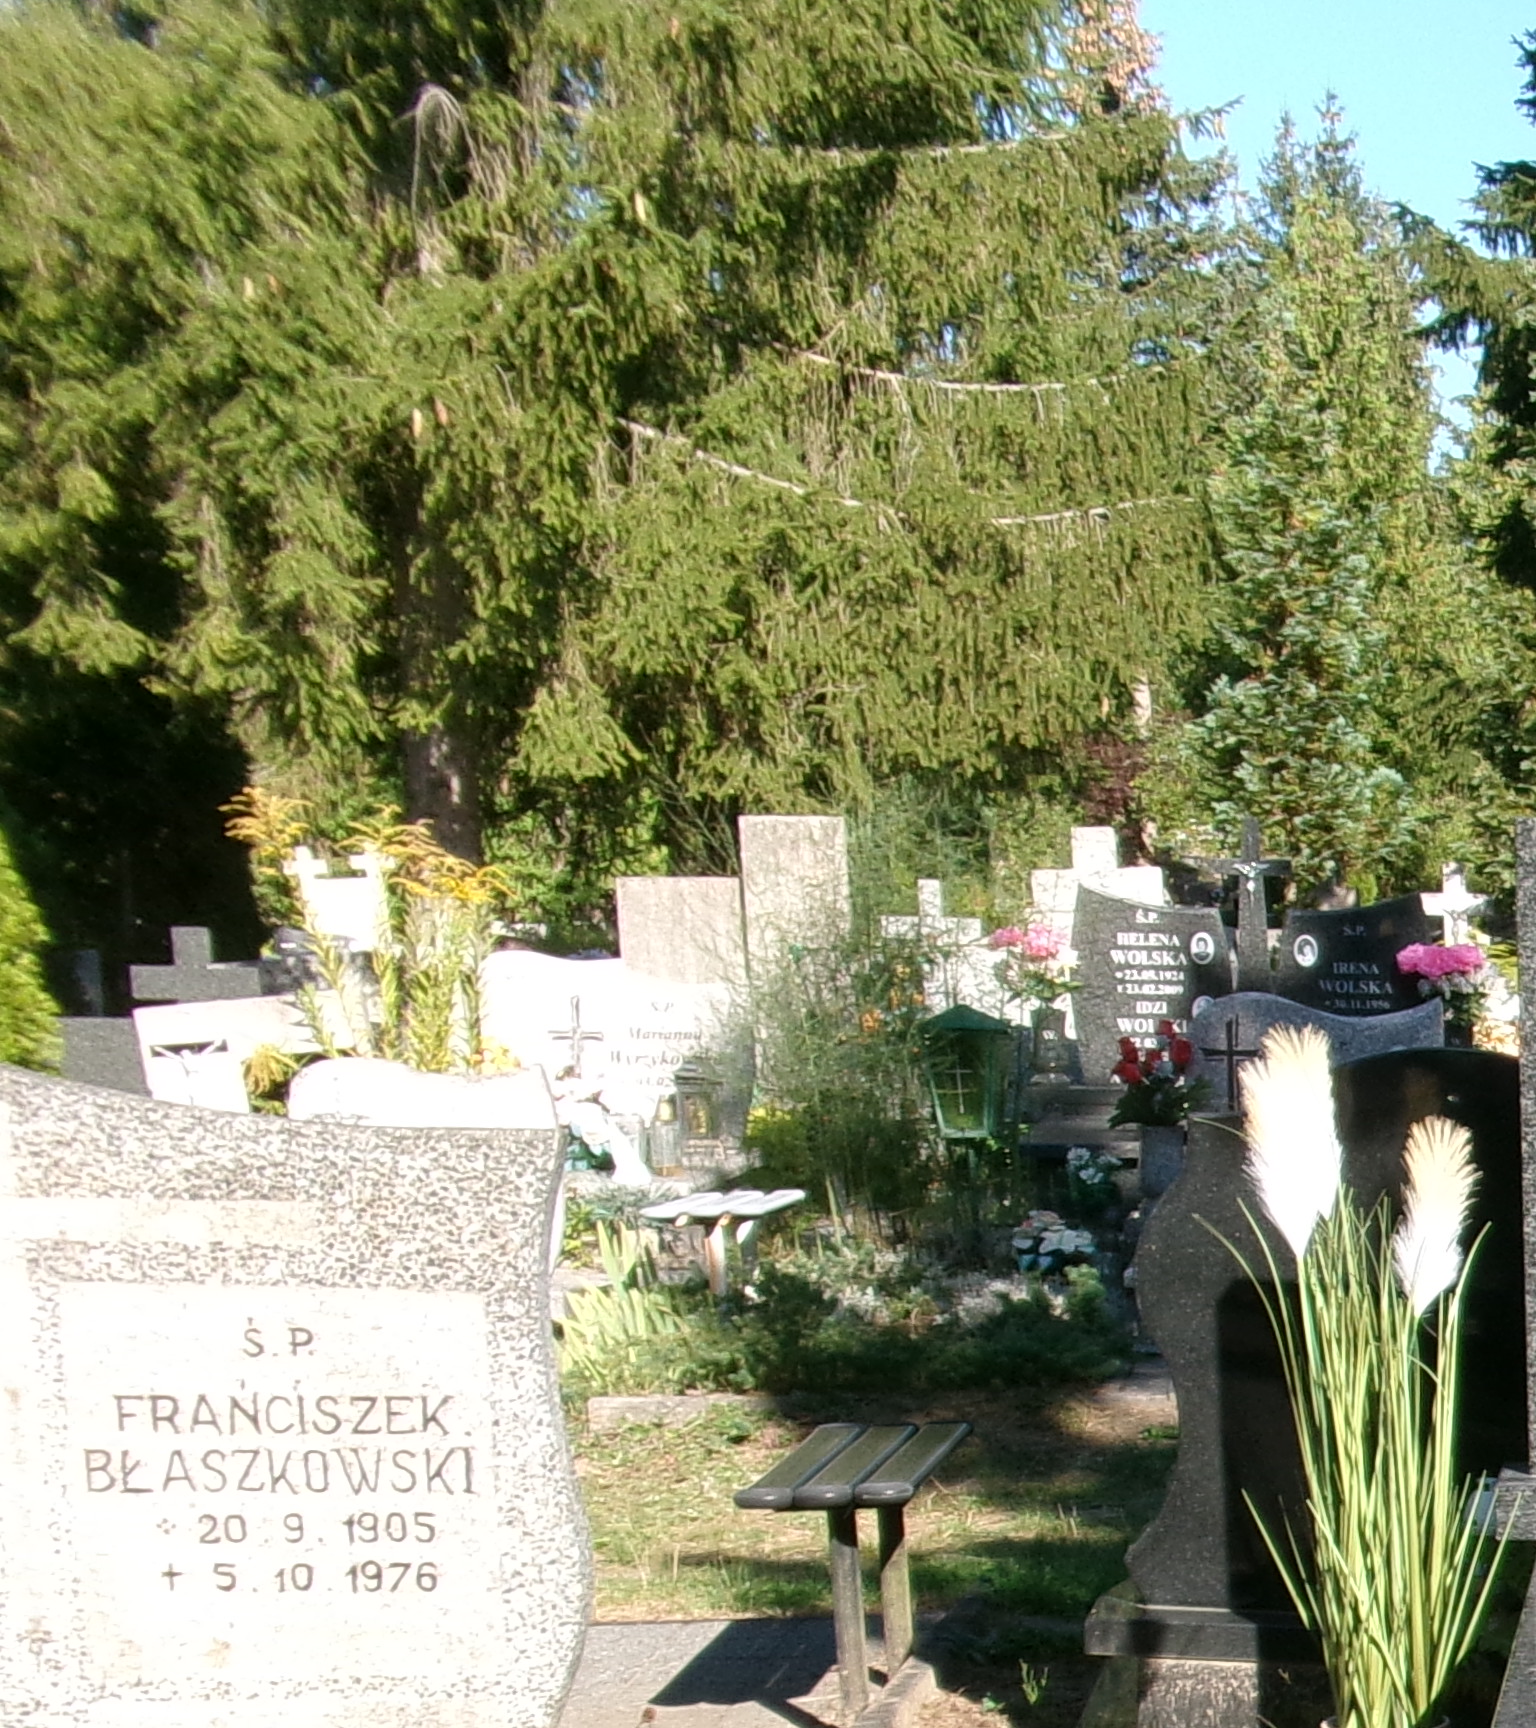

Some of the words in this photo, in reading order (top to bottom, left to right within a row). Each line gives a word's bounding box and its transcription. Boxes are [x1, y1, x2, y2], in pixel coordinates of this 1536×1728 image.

[1116, 932, 1181, 947] HELENA
[1109, 949, 1188, 966] WOLSKA
[1332, 962, 1380, 975] IRENA
[1319, 979, 1393, 994] WOLSKA
[1135, 1001, 1168, 1015] IDZI
[1116, 1017, 1188, 1034] WOLKI
[112, 1393, 452, 1437] FRANCISZEK
[82, 1445, 481, 1495] BŁASZKOWSKI
